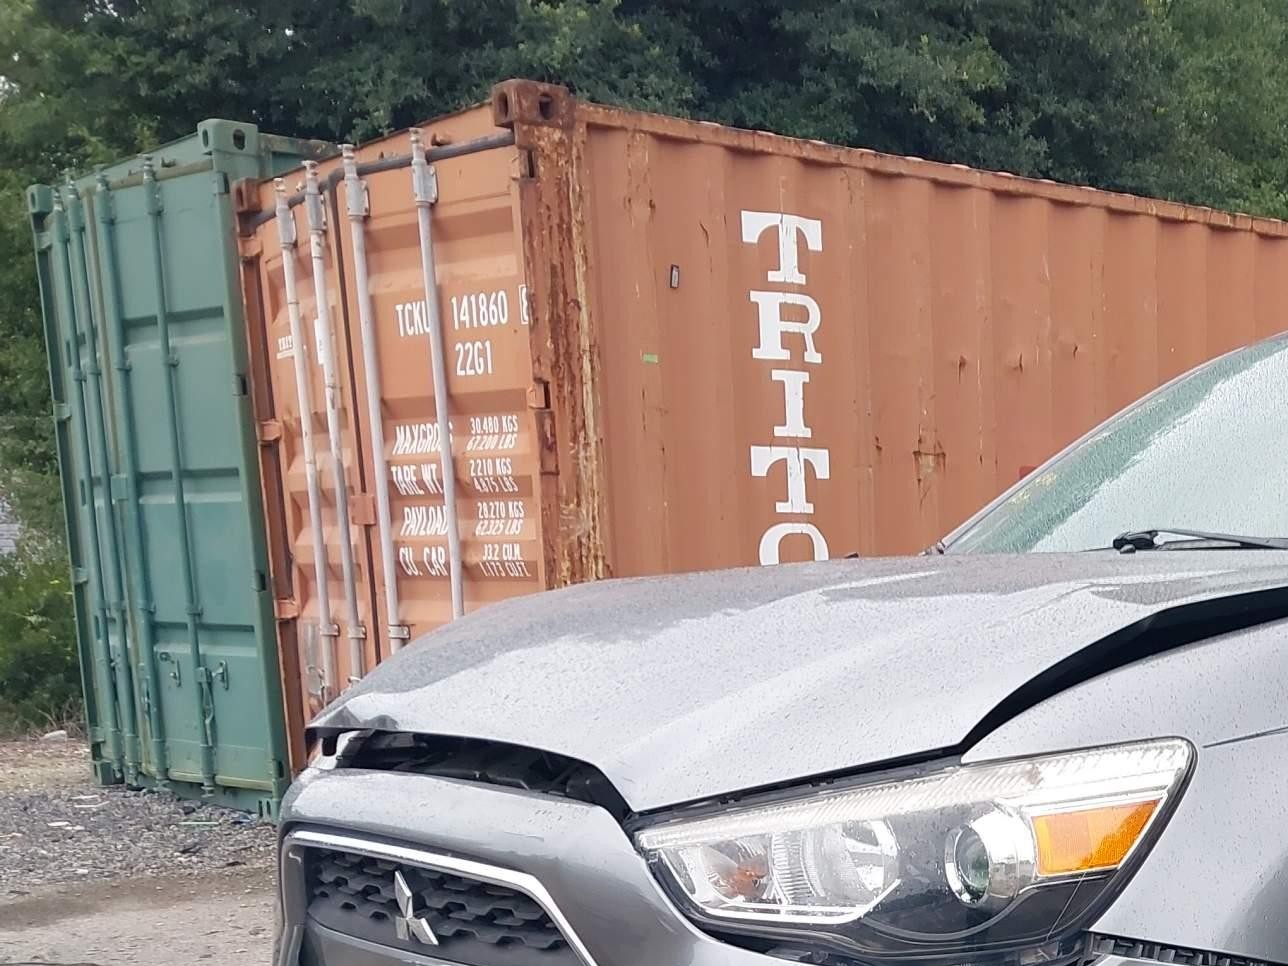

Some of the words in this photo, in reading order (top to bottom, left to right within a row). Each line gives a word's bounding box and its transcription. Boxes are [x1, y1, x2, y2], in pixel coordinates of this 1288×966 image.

[395, 300, 430, 337] TCKU
[451, 290, 509, 330] 141860
[455, 340, 493, 376] 22G1
[741, 210, 830, 566] TRITO
[470, 416, 499, 434] 30.480
[501, 415, 518, 433] KGS
[499, 433, 518, 449] LBS
[391, 465, 424, 495] TARE
[496, 457, 512, 475] KGS
[400, 505, 449, 536] PAYLOAD
[508, 501, 524, 518] KGS
[505, 519, 523, 535] LBS
